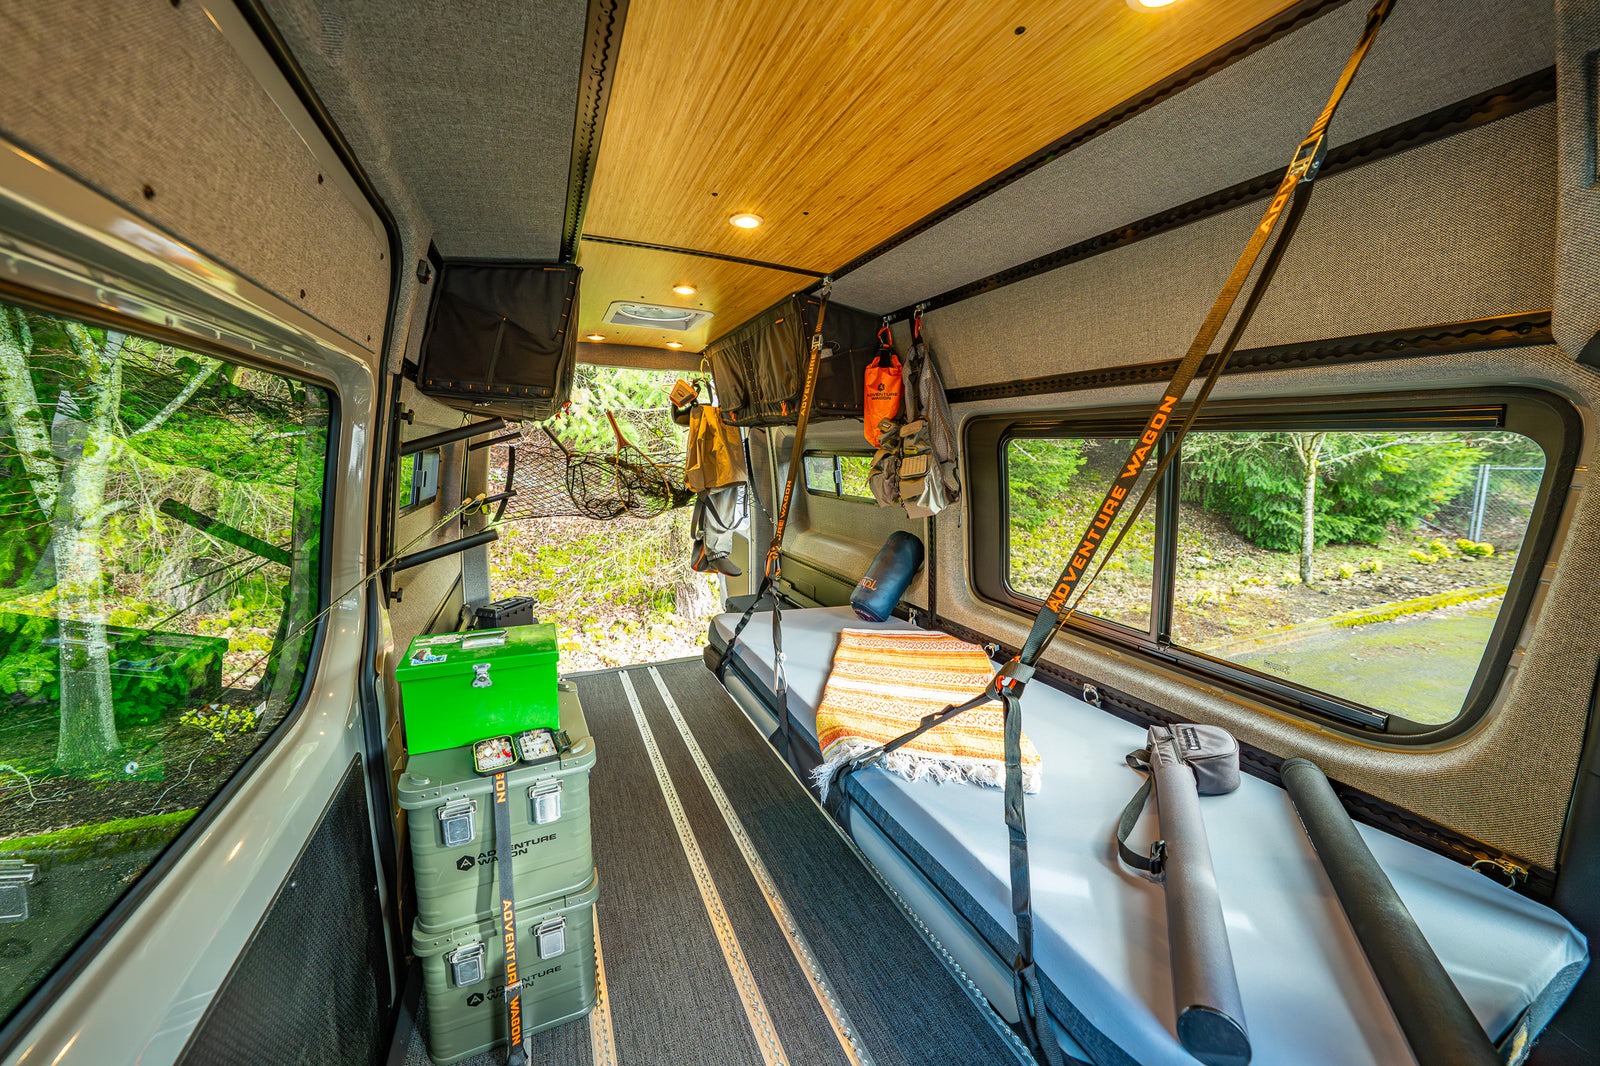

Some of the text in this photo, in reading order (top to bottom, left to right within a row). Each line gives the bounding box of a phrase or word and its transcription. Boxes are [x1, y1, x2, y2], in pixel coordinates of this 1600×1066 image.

[801, 353, 817, 416] ADVENTURE
[780, 480, 792, 518] WAGON
[1045, 395, 1178, 614] ADVENTURE WAGON
[477, 848, 528, 866] WAON
[486, 965, 562, 996] ADNTURE
[509, 995, 521, 1047] WAGON
